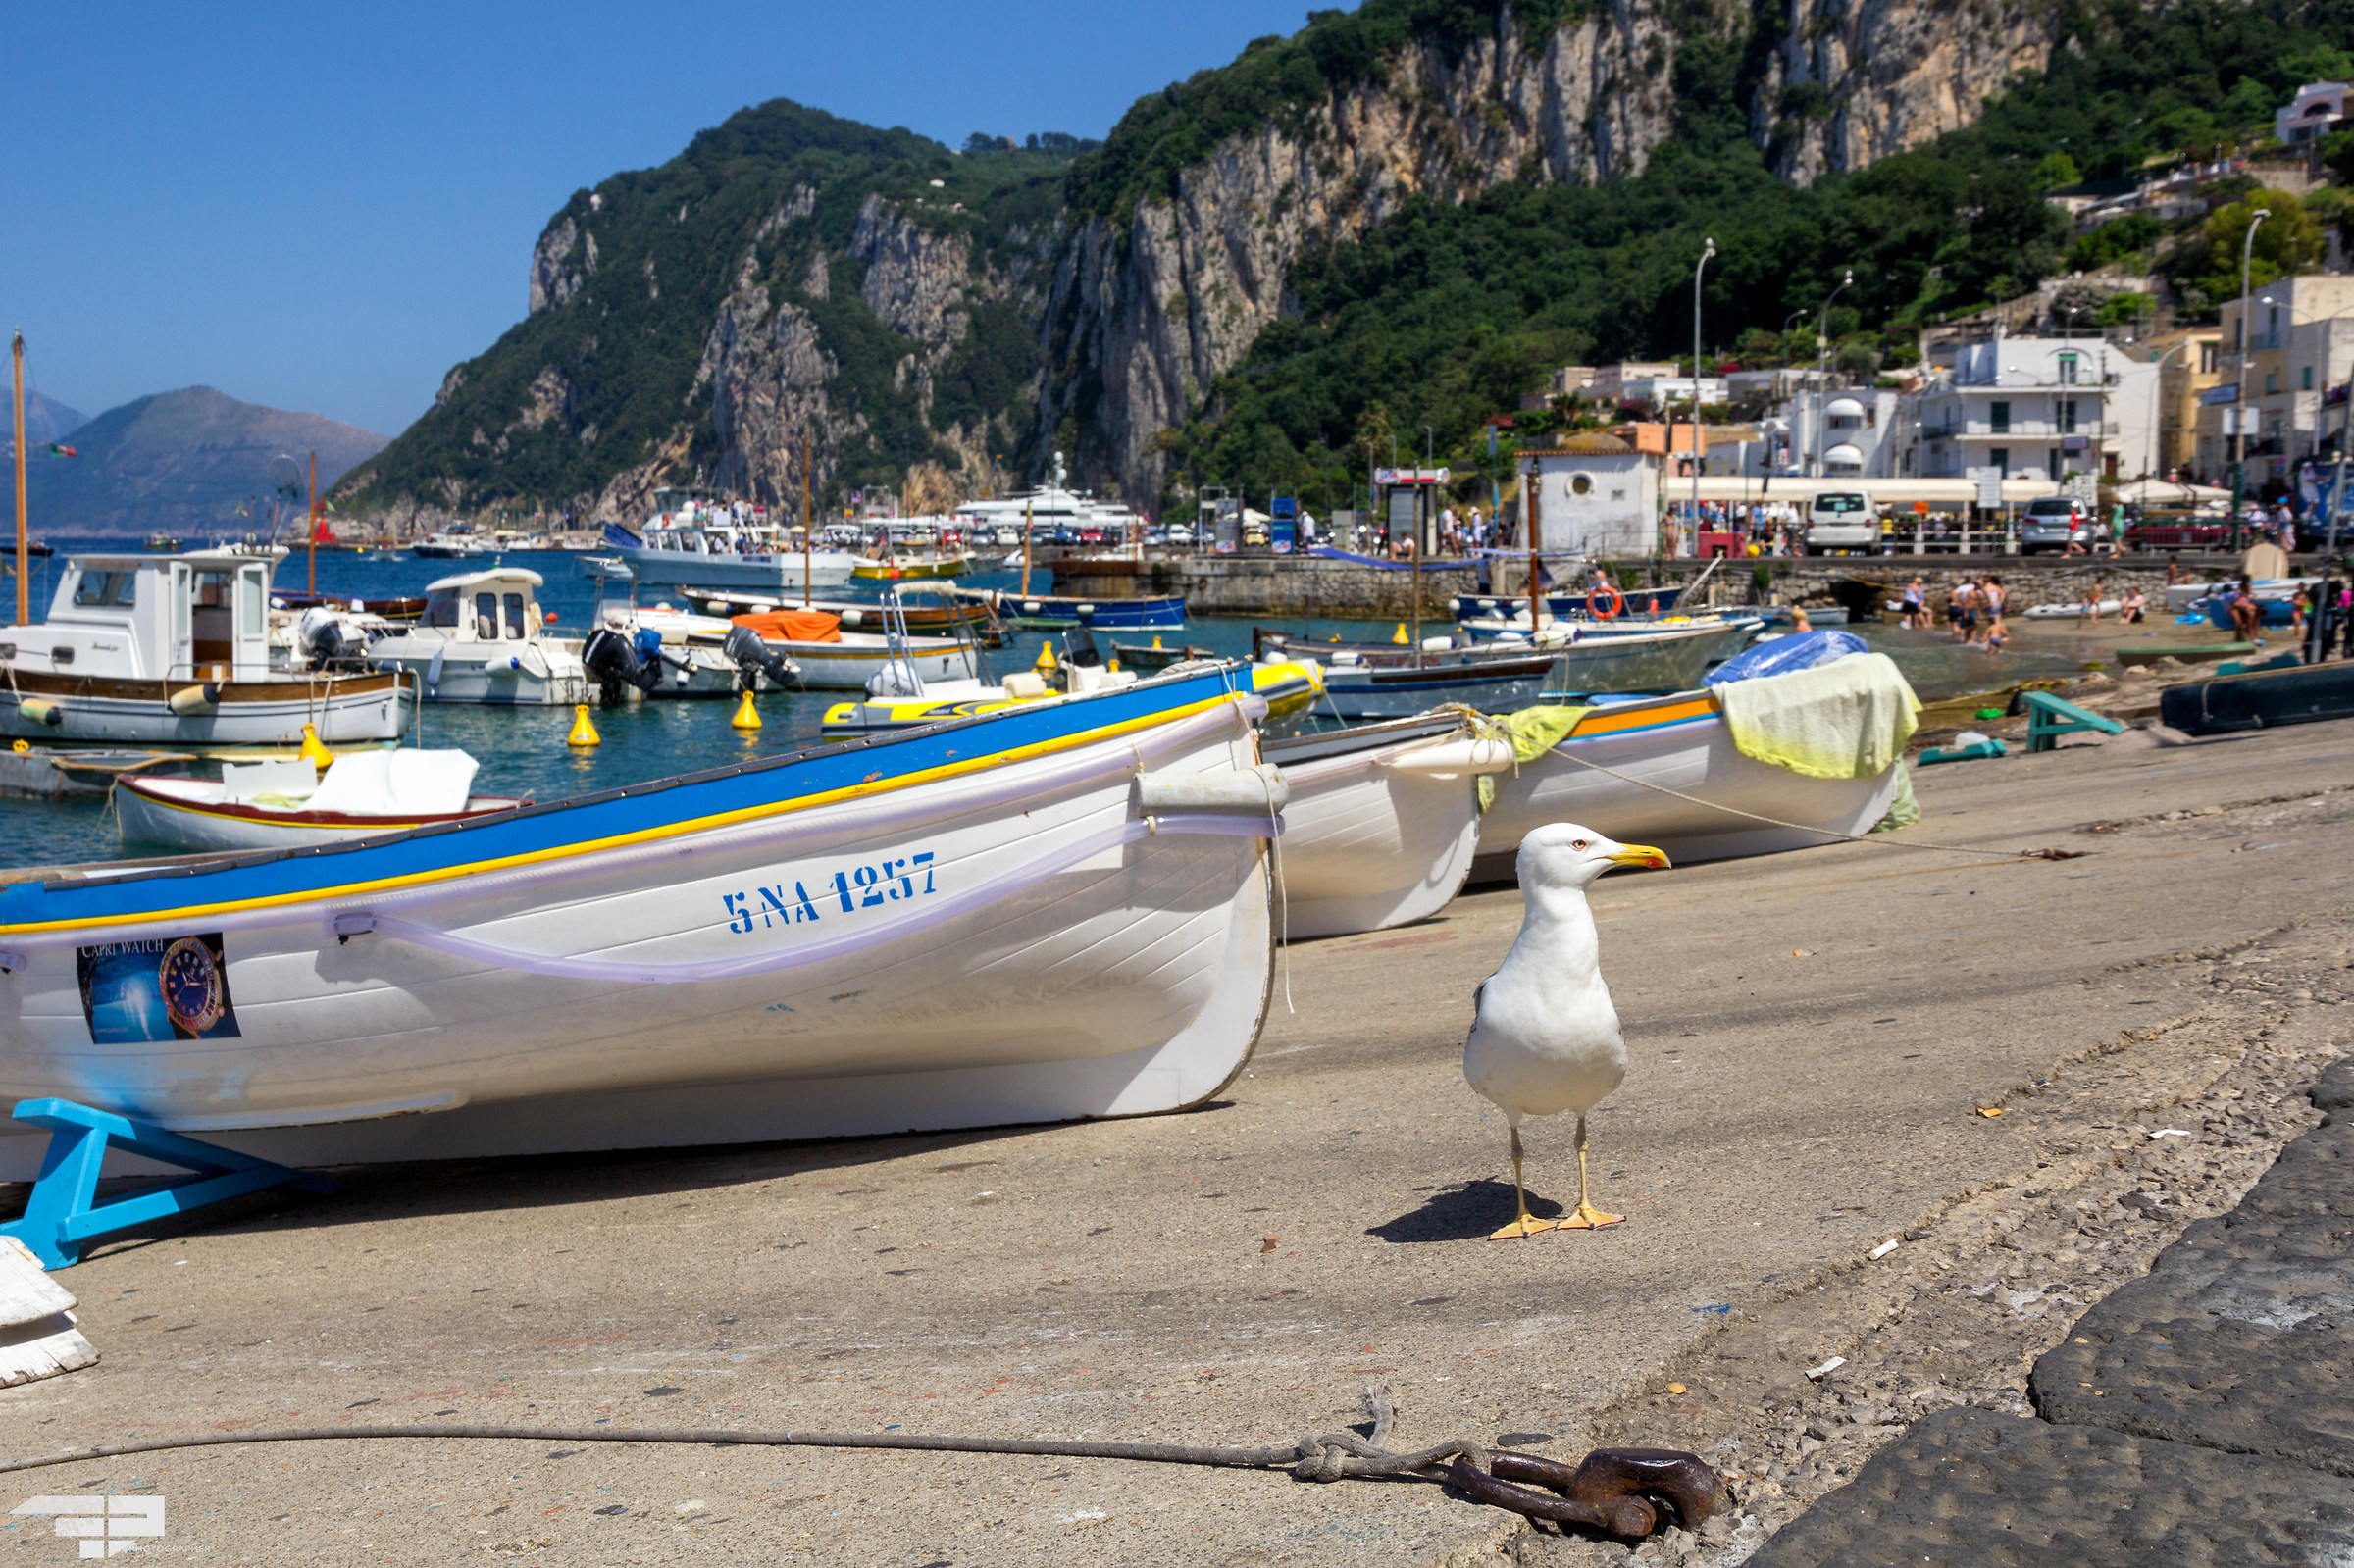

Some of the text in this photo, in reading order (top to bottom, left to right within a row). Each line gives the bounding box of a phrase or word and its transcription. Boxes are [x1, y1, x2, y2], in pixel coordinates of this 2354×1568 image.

[829, 851, 937, 913] 1257
[81, 937, 164, 958] CAPRI WATCH
